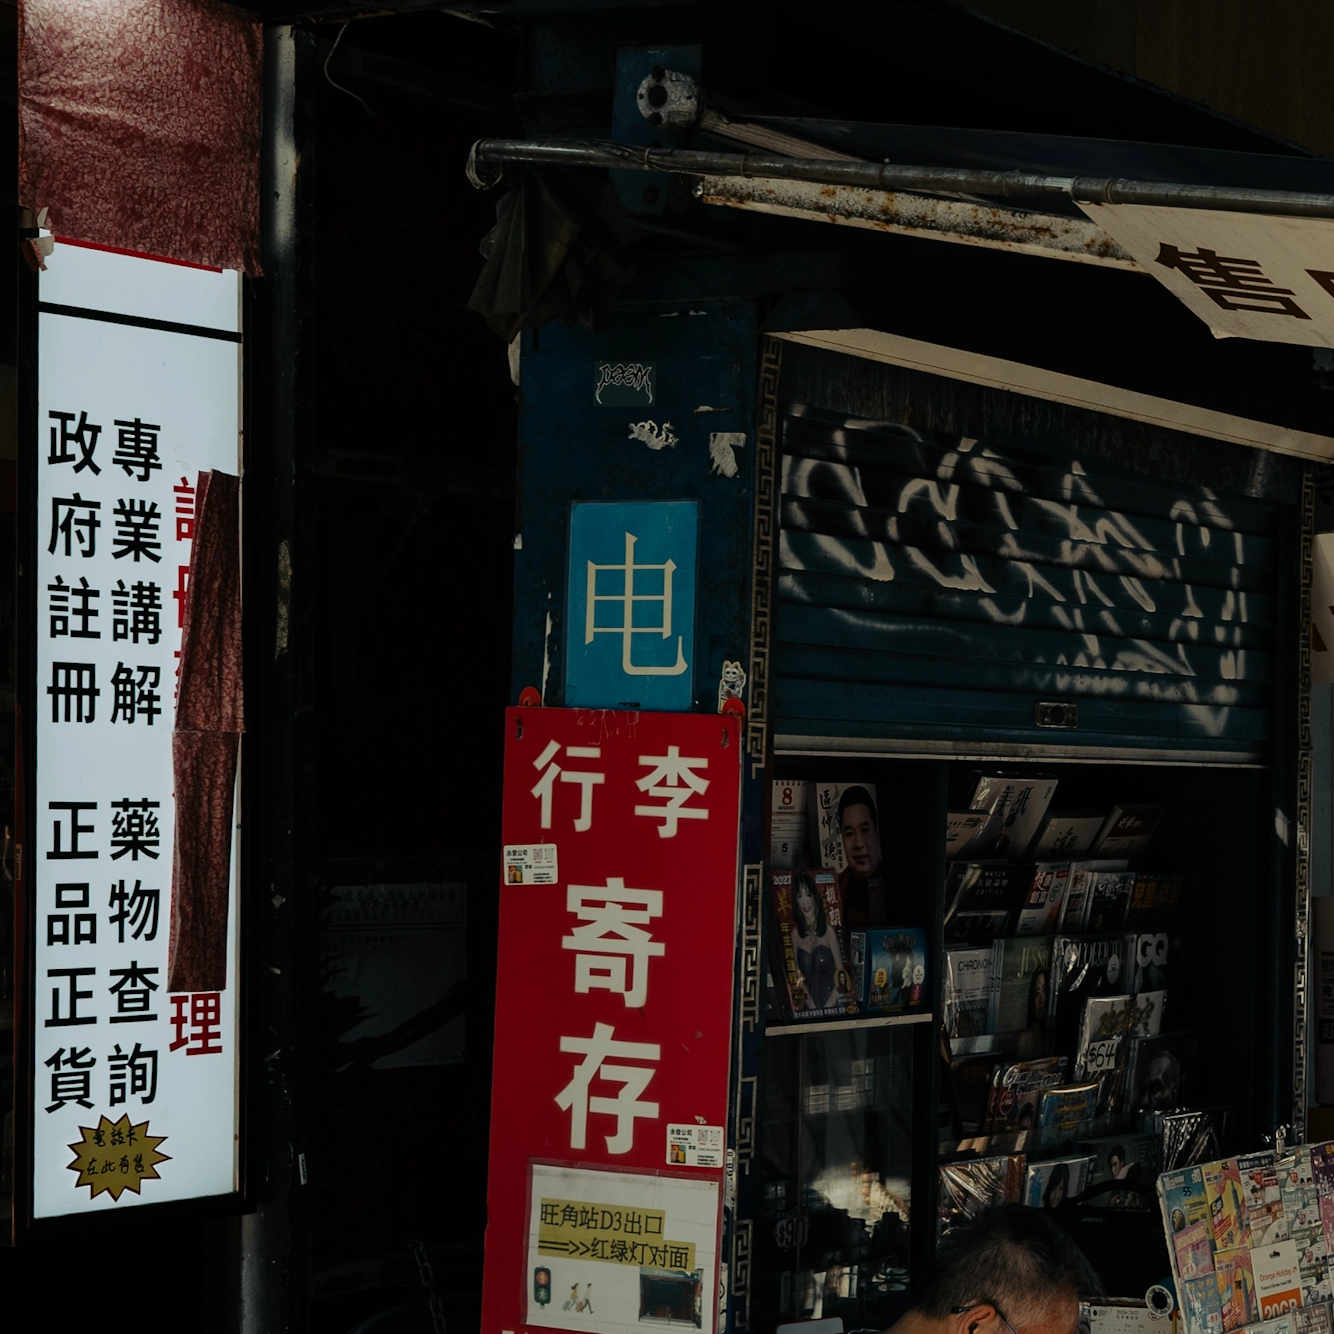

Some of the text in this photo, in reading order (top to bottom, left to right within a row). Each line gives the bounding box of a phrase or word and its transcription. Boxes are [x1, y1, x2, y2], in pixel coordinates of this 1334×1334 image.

[585, 531, 688, 676] 电
[43, 410, 103, 1113] 政府註冊 正品正貨
[107, 416, 164, 1108] 專業講解 藥物查詢
[531, 739, 710, 838] 行李
[782, 787, 792, 805] 8
[781, 843, 788, 853] 5
[773, 875, 791, 885] 2027
[1136, 933, 1169, 967] GQ
[1089, 1044, 1115, 1069] $64
[540, 1203, 662, 1235] 旺角站D3出口
[1259, 1269, 1292, 1282] Orange Holiday
[1264, 1297, 1298, 1319] 20GB
